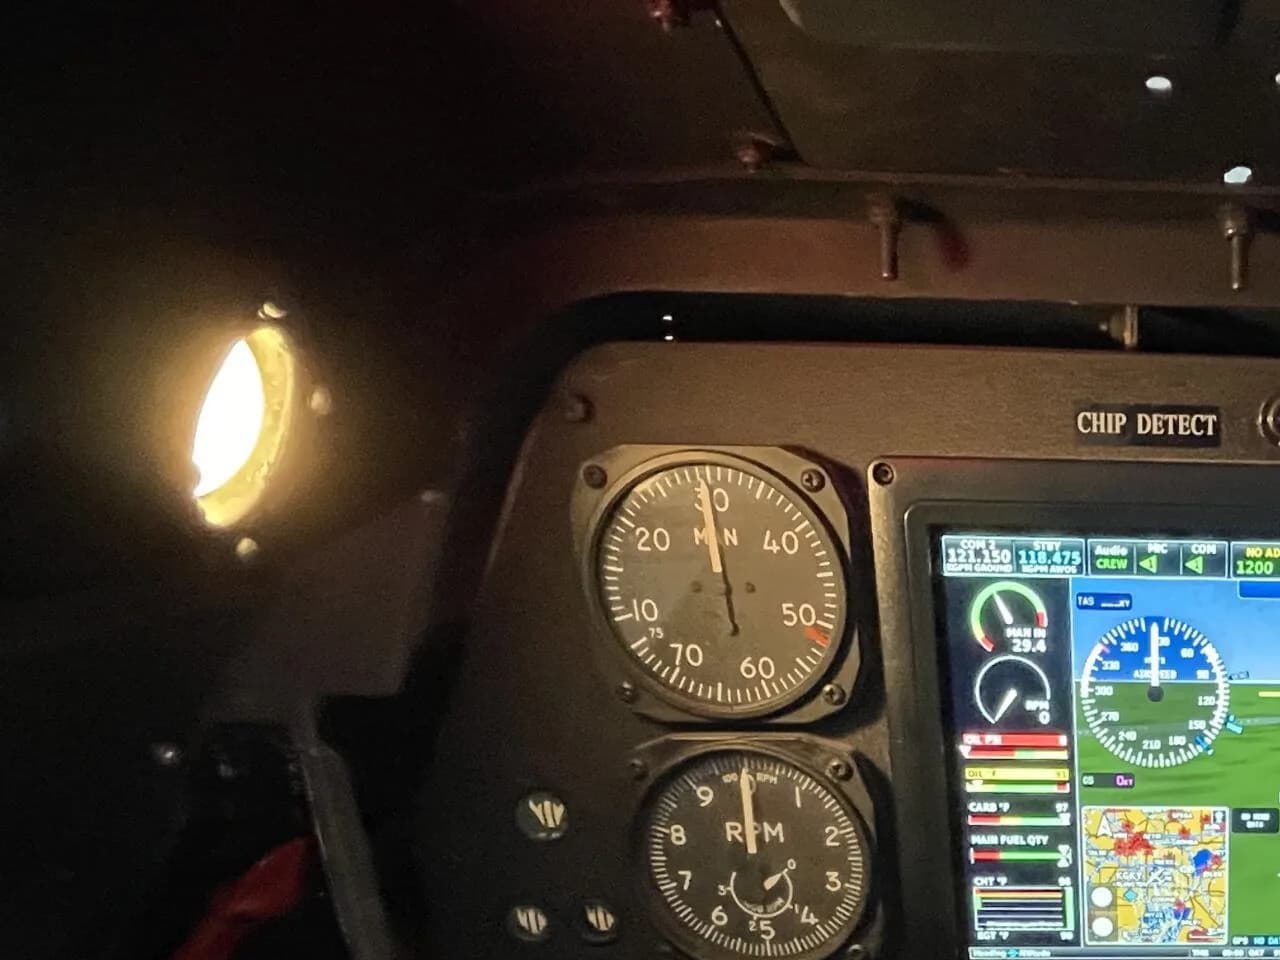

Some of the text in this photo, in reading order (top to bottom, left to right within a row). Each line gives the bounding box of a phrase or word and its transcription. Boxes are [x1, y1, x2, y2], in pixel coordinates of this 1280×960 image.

[1077, 411, 1217, 436] CHIP DETECT
[635, 528, 670, 551] 20
[694, 528, 738, 546] MN
[763, 531, 798, 554] 40
[960, 540, 995, 550] COM 2
[1034, 542, 1060, 551] STBY
[1095, 545, 1128, 556] Audio
[1148, 544, 1168, 554] MIC
[1191, 544, 1216, 555] COM
[948, 548, 1011, 564] 121.150
[1019, 551, 1081, 565] 118.475
[1246, 547, 1263, 558] NO
[1096, 559, 1128, 570] CREW
[1236, 561, 1273, 575] 1200
[1077, 596, 1094, 606] TAS
[633, 599, 658, 621] 10
[782, 603, 816, 626] 50
[649, 628, 663, 639] 75
[1012, 639, 1047, 652] 29.4
[670, 644, 703, 666] 70
[1181, 648, 1194, 658] 60
[740, 657, 775, 679] 60
[1102, 661, 1120, 670] 330
[1095, 686, 1113, 695] 300
[1198, 696, 1215, 705] 120
[1039, 711, 1050, 724] 0
[1101, 712, 1119, 721] 270
[1118, 731, 1137, 741] 240
[1142, 740, 1161, 749] 210
[696, 787, 713, 807] 9
[796, 786, 800, 808] 1
[671, 825, 686, 844] 8
[825, 827, 840, 846] 2
[971, 835, 998, 844] MAIN
[1001, 835, 1027, 844] FUEL
[788, 860, 796, 869] 0
[678, 871, 691, 890] 7
[825, 872, 841, 891] 3
[718, 885, 726, 895] 3
[795, 904, 798, 913] 1
[801, 906, 817, 924] 4
[712, 906, 727, 925] 6
[750, 921, 757, 931] 2
[761, 920, 775, 939] 5
